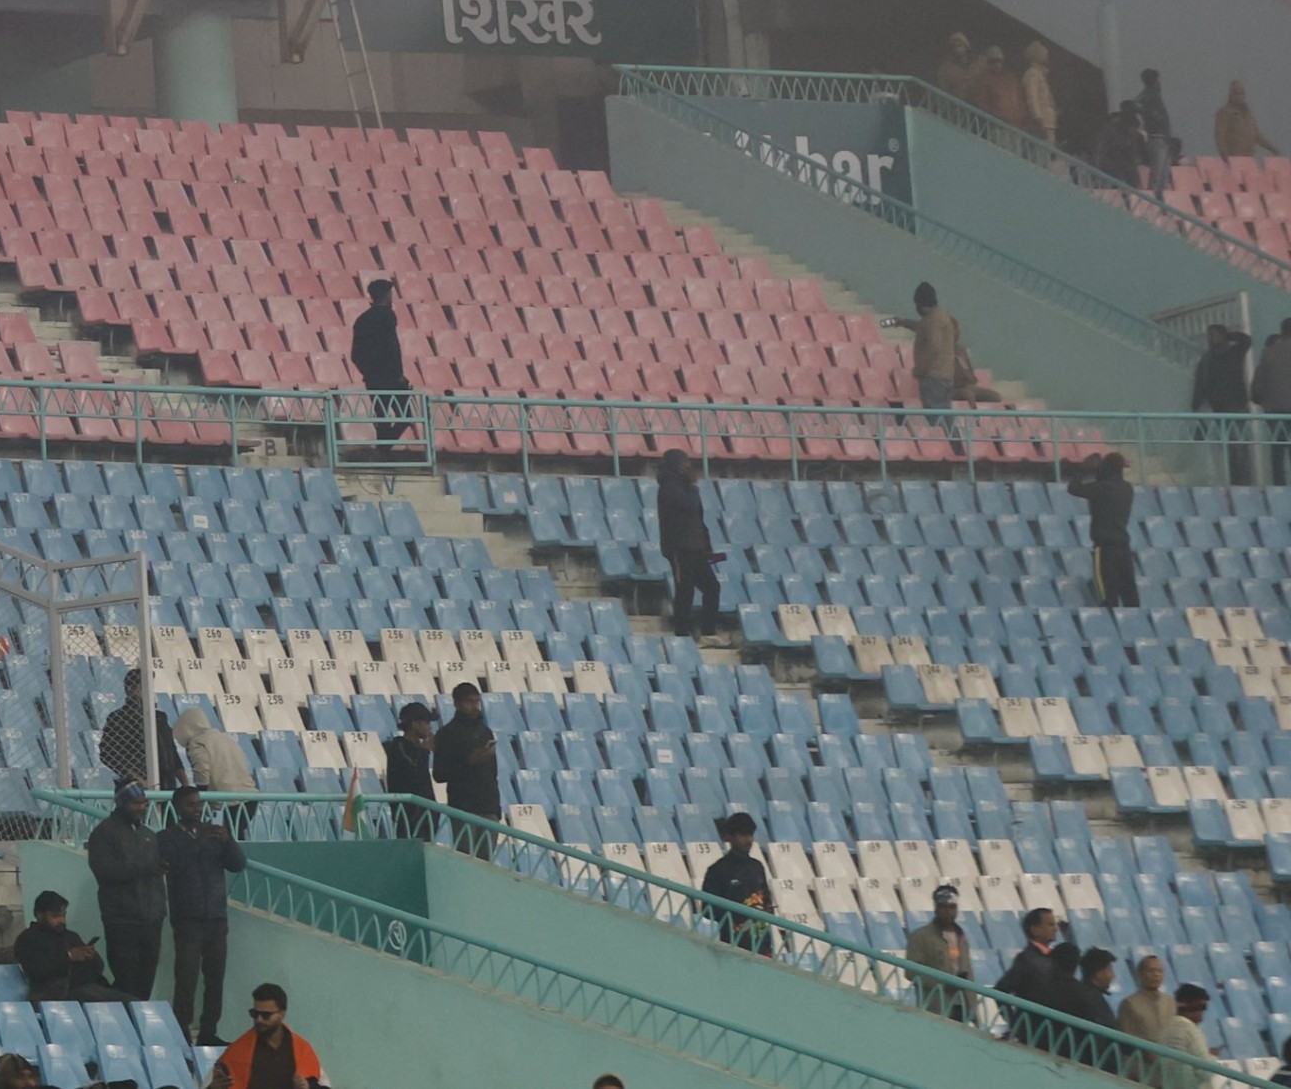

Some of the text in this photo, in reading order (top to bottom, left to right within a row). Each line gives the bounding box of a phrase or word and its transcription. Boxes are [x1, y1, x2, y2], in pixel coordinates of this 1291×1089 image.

[159, 627, 175, 638] 261
[205, 628, 222, 639] 260
[294, 630, 311, 640] 258
[336, 630, 353, 641] 257
[387, 630, 404, 640] 256
[426, 631, 443, 641] 255
[466, 631, 484, 641] 254
[508, 631, 524, 641] 253
[188, 660, 203, 671] 261
[230, 660, 247, 671] 260
[277, 659, 295, 670] 259
[320, 660, 337, 671] 258
[363, 662, 380, 673] 257
[403, 662, 420, 673] 256
[447, 662, 464, 672] 255
[494, 662, 511, 672] 254
[534, 662, 551, 672] 253
[579, 662, 596, 672] 252
[225, 695, 241, 705] 259
[267, 695, 284, 705] 258
[309, 732, 327, 743] 248
[352, 733, 368, 743] 247
